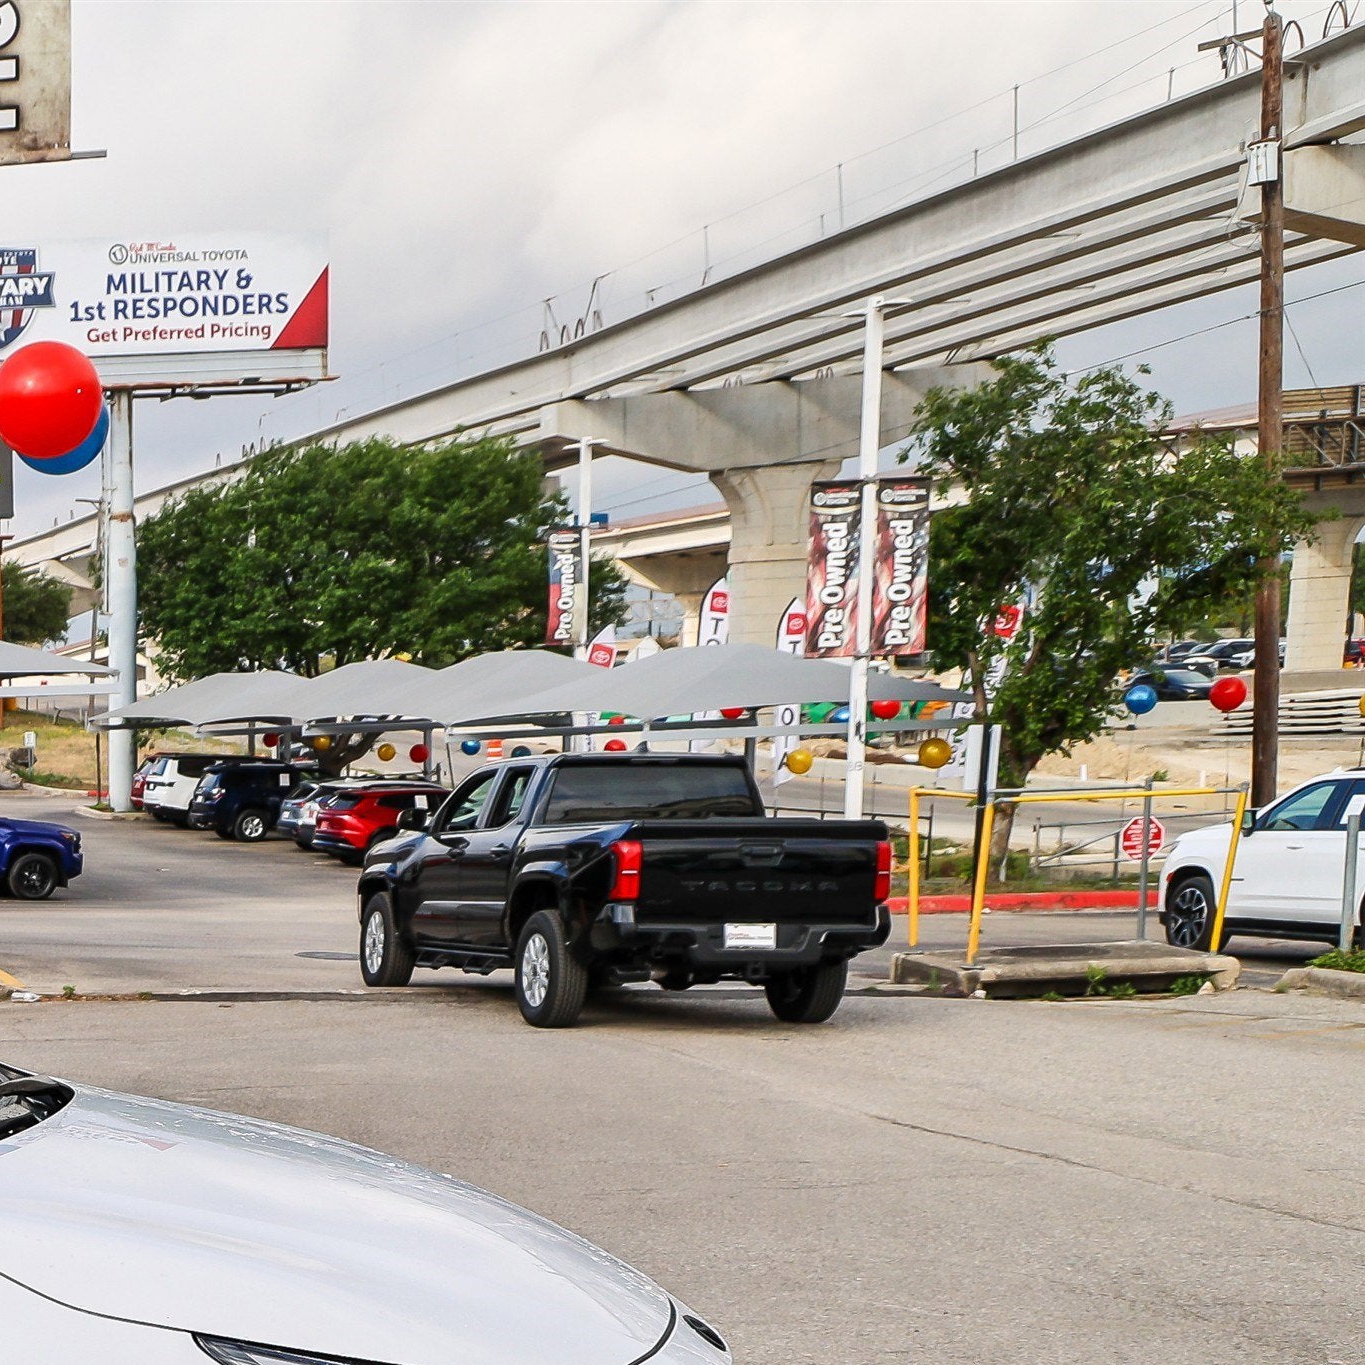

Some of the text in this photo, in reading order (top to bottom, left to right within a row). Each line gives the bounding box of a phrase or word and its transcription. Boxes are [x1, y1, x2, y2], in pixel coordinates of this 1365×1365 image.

[130, 249, 249, 264] UNIVERSAL TOYOTA
[105, 267, 253, 295] MILITARY &
[69, 291, 289, 322] 1st RESPONDERS
[86, 321, 271, 343] Get Preferred Pricing
[820, 521, 849, 606] Owned
[887, 519, 914, 602] Owned
[554, 612, 573, 640] Pre
[818, 607, 844, 648] Pre
[884, 605, 911, 646] Pre
[681, 879, 839, 892] TACOMA
